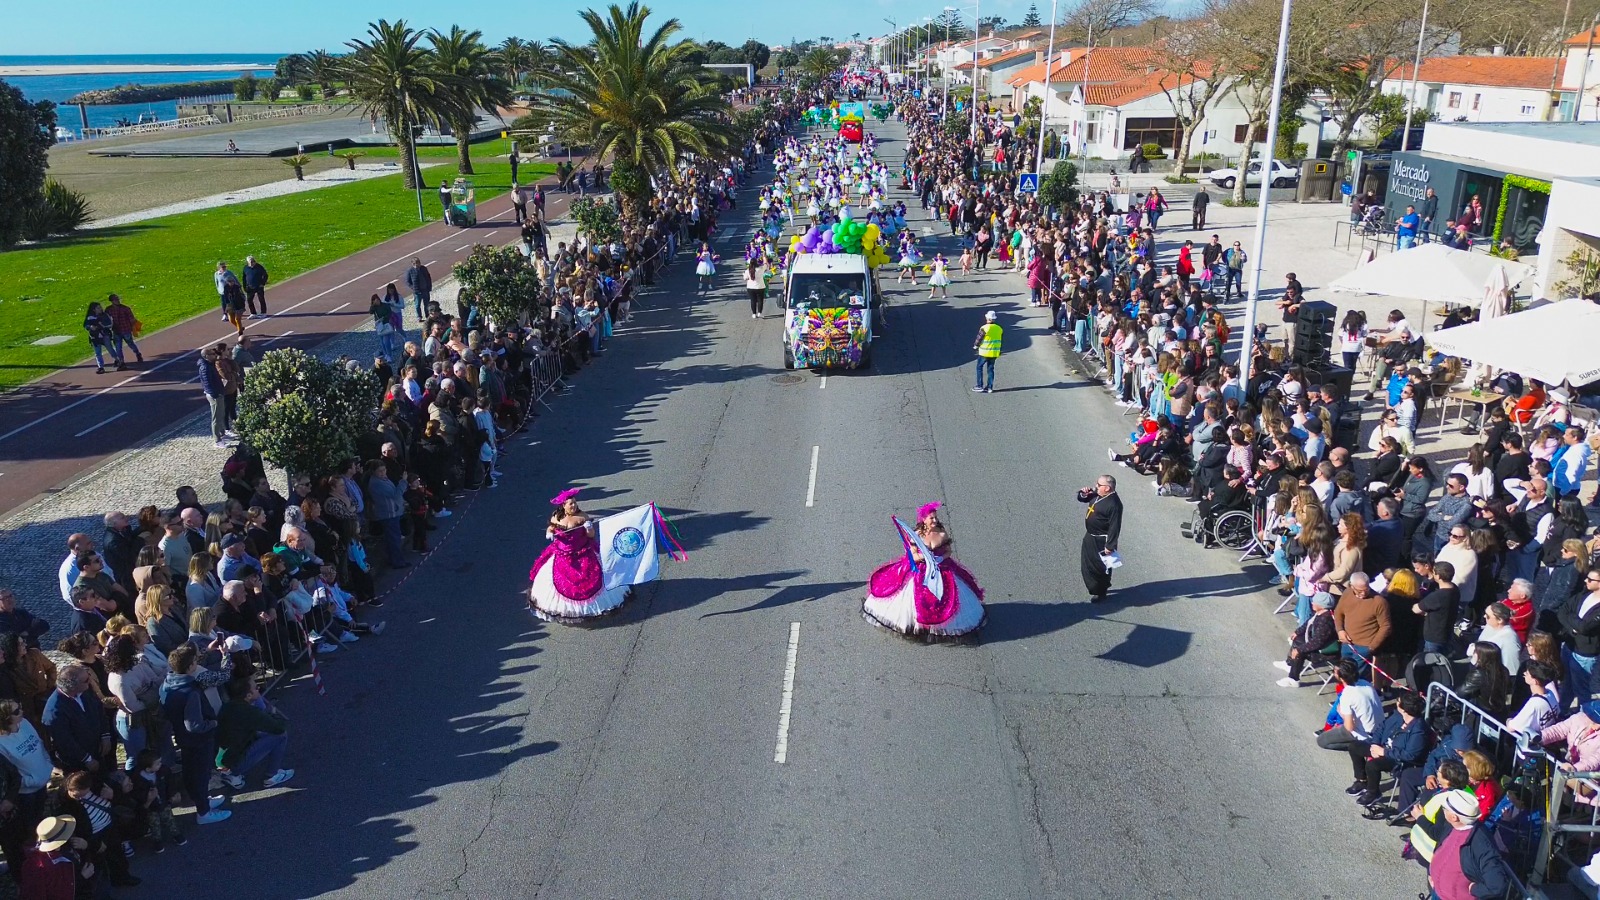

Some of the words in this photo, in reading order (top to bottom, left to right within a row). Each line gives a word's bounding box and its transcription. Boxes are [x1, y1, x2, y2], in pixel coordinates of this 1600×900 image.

[1393, 160, 1429, 182] Mercado
[1391, 178, 1427, 202] Municipal
[1578, 369, 1598, 380] SUPER
